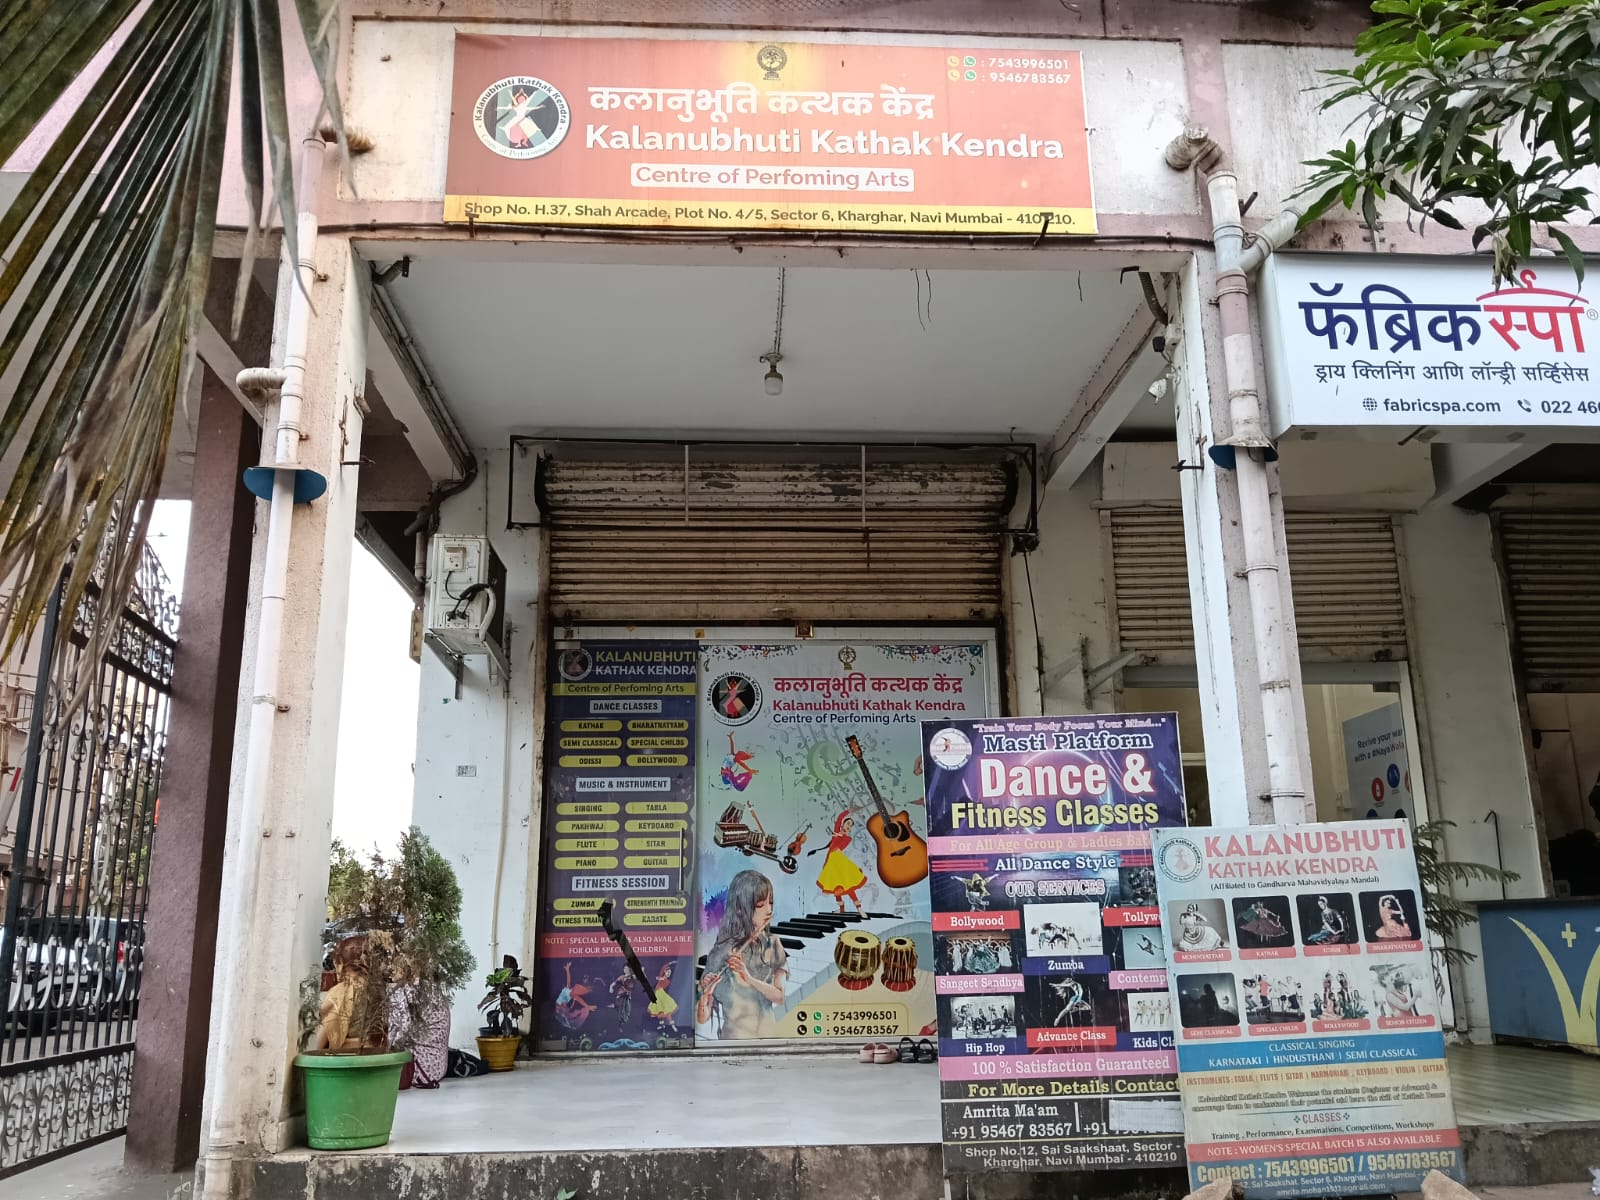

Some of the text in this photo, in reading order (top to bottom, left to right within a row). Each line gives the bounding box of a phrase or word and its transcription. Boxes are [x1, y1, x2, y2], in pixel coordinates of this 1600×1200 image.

[989, 57, 1069, 70] 7543996501
[990, 71, 1071, 84] 9546783567
[587, 82, 935, 123] कलानुभूति कत्थक केंद्र
[585, 125, 800, 154] Kalanubhuti
[811, 129, 932, 156] Kathak
[941, 131, 1064, 160] Kendra
[636, 166, 910, 190] Centre of Perfoming Arts
[464, 202, 502, 217] Shop
[506, 204, 531, 216] No.
[535, 204, 571, 217] H.37,
[575, 205, 611, 217] Shah
[615, 206, 671, 220] Arcade,
[675, 207, 704, 219] Plot
[707, 208, 732, 220] No.
[735, 208, 767, 221] 4/5,
[770, 208, 818, 221] Sector
[821, 210, 834, 223] 6,
[838, 210, 906, 225] Kharghar,
[910, 212, 942, 224] Navi
[945, 212, 1003, 225] Mumbai
[1314, 364, 1346, 384] ड्राय
[1352, 360, 1415, 381] क्लिनिंग
[1423, 361, 1464, 381] आणि
[1469, 360, 1516, 385] लॉन्ड्री
[1384, 398, 1501, 416] fabricspa.com
[1541, 401, 1572, 413] 022
[595, 651, 696, 662] KALANUBHUTI
[595, 665, 697, 675] KATHAK KENDRA
[567, 683, 685, 694] Centre of Perfoming Arts
[773, 672, 963, 698] कलानुभूति कत्थक केंद्र
[593, 702, 658, 711] DANCE CLASSES
[773, 699, 966, 711] Kalanubhuti Kathak Kendra
[773, 713, 916, 726] Centre of Perfoming Arts
[1006, 720, 1123, 732] Your Body Your
[984, 733, 1047, 753] Masti
[1053, 730, 1154, 751] Platform
[980, 752, 1154, 798] Dance &
[579, 780, 668, 789] MUSIC INSTRUMENT
[951, 799, 1159, 829] Fitness Classes
[638, 822, 675, 830] KEYBOARD
[951, 835, 1122, 854] For All Age Group & Ladies
[1204, 828, 1406, 858] KALANUBHUTI
[575, 859, 597, 867] PIANO
[994, 856, 1117, 872] All Dance Style
[1207, 859, 1291, 879] KATHAK
[1295, 856, 1378, 875] KENDRA
[575, 878, 666, 889] FITNESS SESSION
[1005, 879, 1106, 897] OUR SERVICES
[1210, 876, 1380, 891] (Affiliated Gandharva Mahavidyalaya Mandal)
[570, 900, 596, 908] ZUMBA
[555, 917, 582, 925] FITNESS
[950, 915, 1005, 928] Bollywood
[569, 935, 692, 944] SPECIAL AVAILABLE
[1048, 960, 1084, 971] Zumba
[939, 976, 1024, 991] Sangeet Sandhya
[833, 1011, 898, 1021] 7543996501
[833, 1025, 899, 1035] 9546783567
[1037, 1030, 1106, 1043] Advance Class
[965, 1042, 1006, 1056] Hip Hop
[1133, 1037, 1158, 1048] Kids
[1268, 1039, 1355, 1052] CLASSICAL SINGING
[972, 1056, 1171, 1075] 100 % Satisfaction Guaranteed
[1208, 1048, 1418, 1068] KARNATAKI HINDUSTHANI SEMI CLASSICAL
[968, 1079, 1110, 1098] For More Details
[962, 1103, 1059, 1119] Amrita Ma'am
[1302, 1112, 1341, 1124] CLASSES
[951, 1122, 1073, 1140] +91 95467 83567
[1083, 1122, 1109, 1135] +91
[1211, 1132, 1241, 1141] Training
[1295, 1125, 1345, 1136] Examinations,
[1345, 1122, 1395, 1133] Competitions,
[1395, 1121, 1435, 1130] Workshops
[965, 1141, 1173, 1159] Shop No.12, Sai Saakshaat, Sector
[1207, 1134, 1442, 1157] NOTE WOMEN'S SPECIAL BATCH ALSO AVAILABLE
[984, 1152, 1178, 1170] Kharghar, Navi Mumbai 410210
[1263, 1150, 1457, 1179] 7543996501 9546783567
